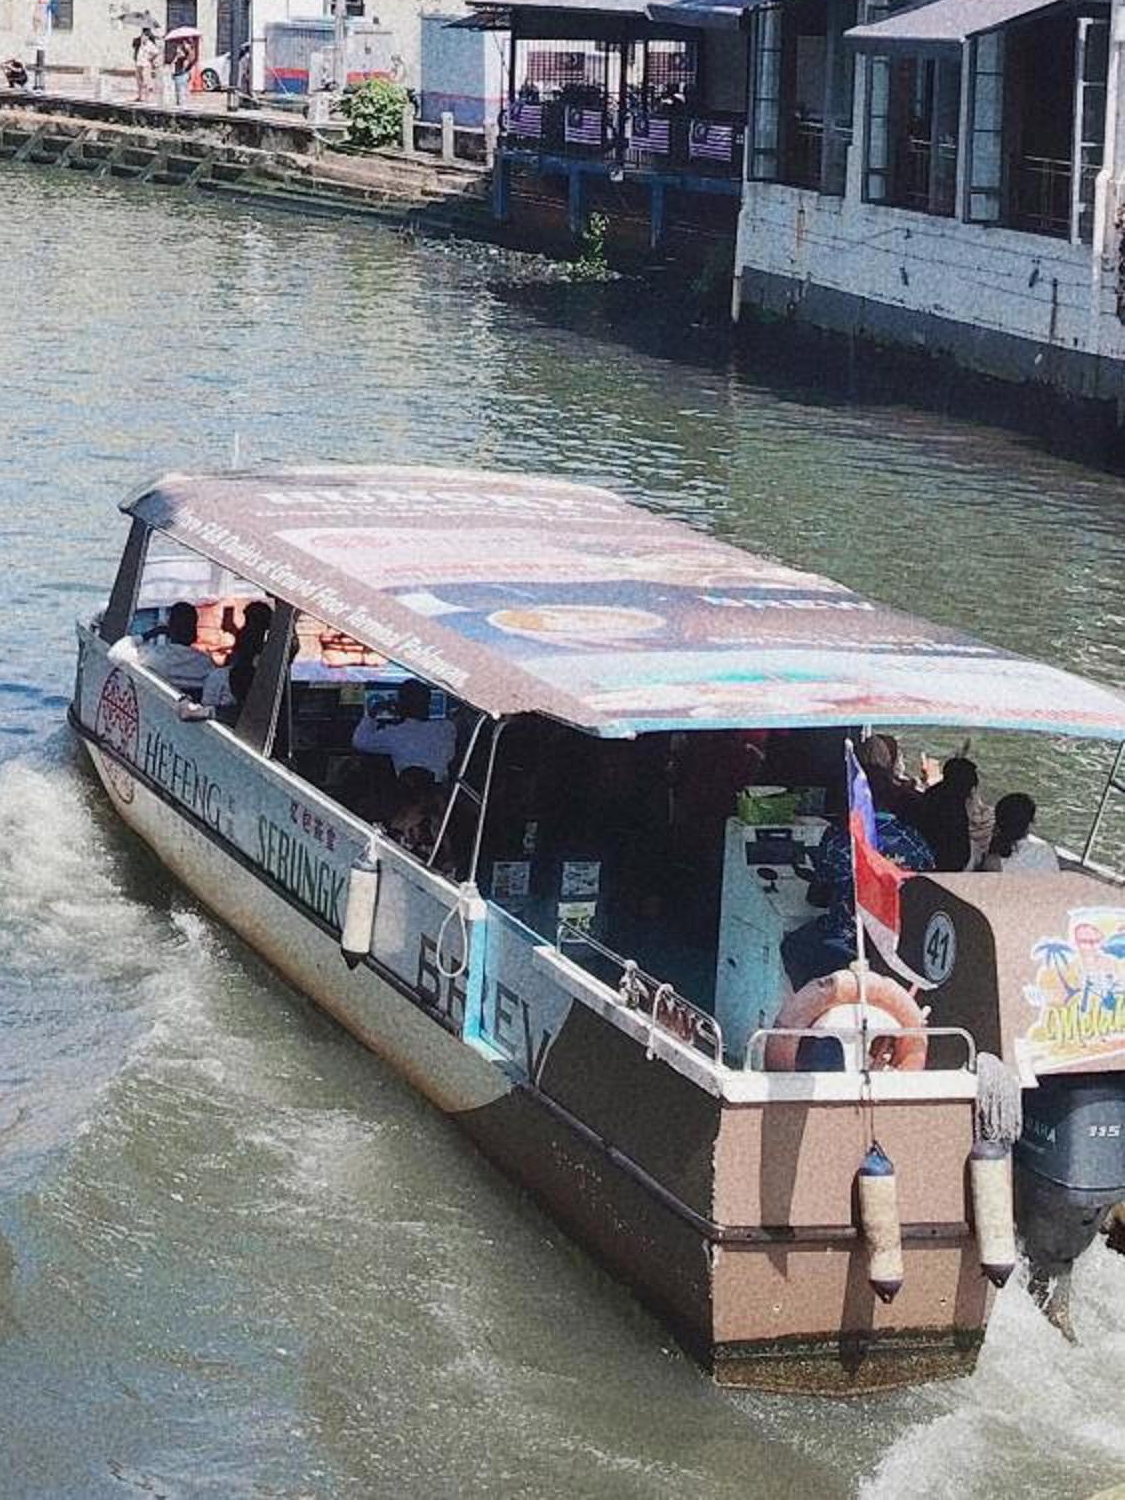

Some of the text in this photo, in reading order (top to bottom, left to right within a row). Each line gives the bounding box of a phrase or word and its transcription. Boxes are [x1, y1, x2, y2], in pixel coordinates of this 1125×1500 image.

[144, 730, 221, 834] HE'FENG
[926, 927, 950, 970] 41
[1089, 1124, 1121, 1138] 115
